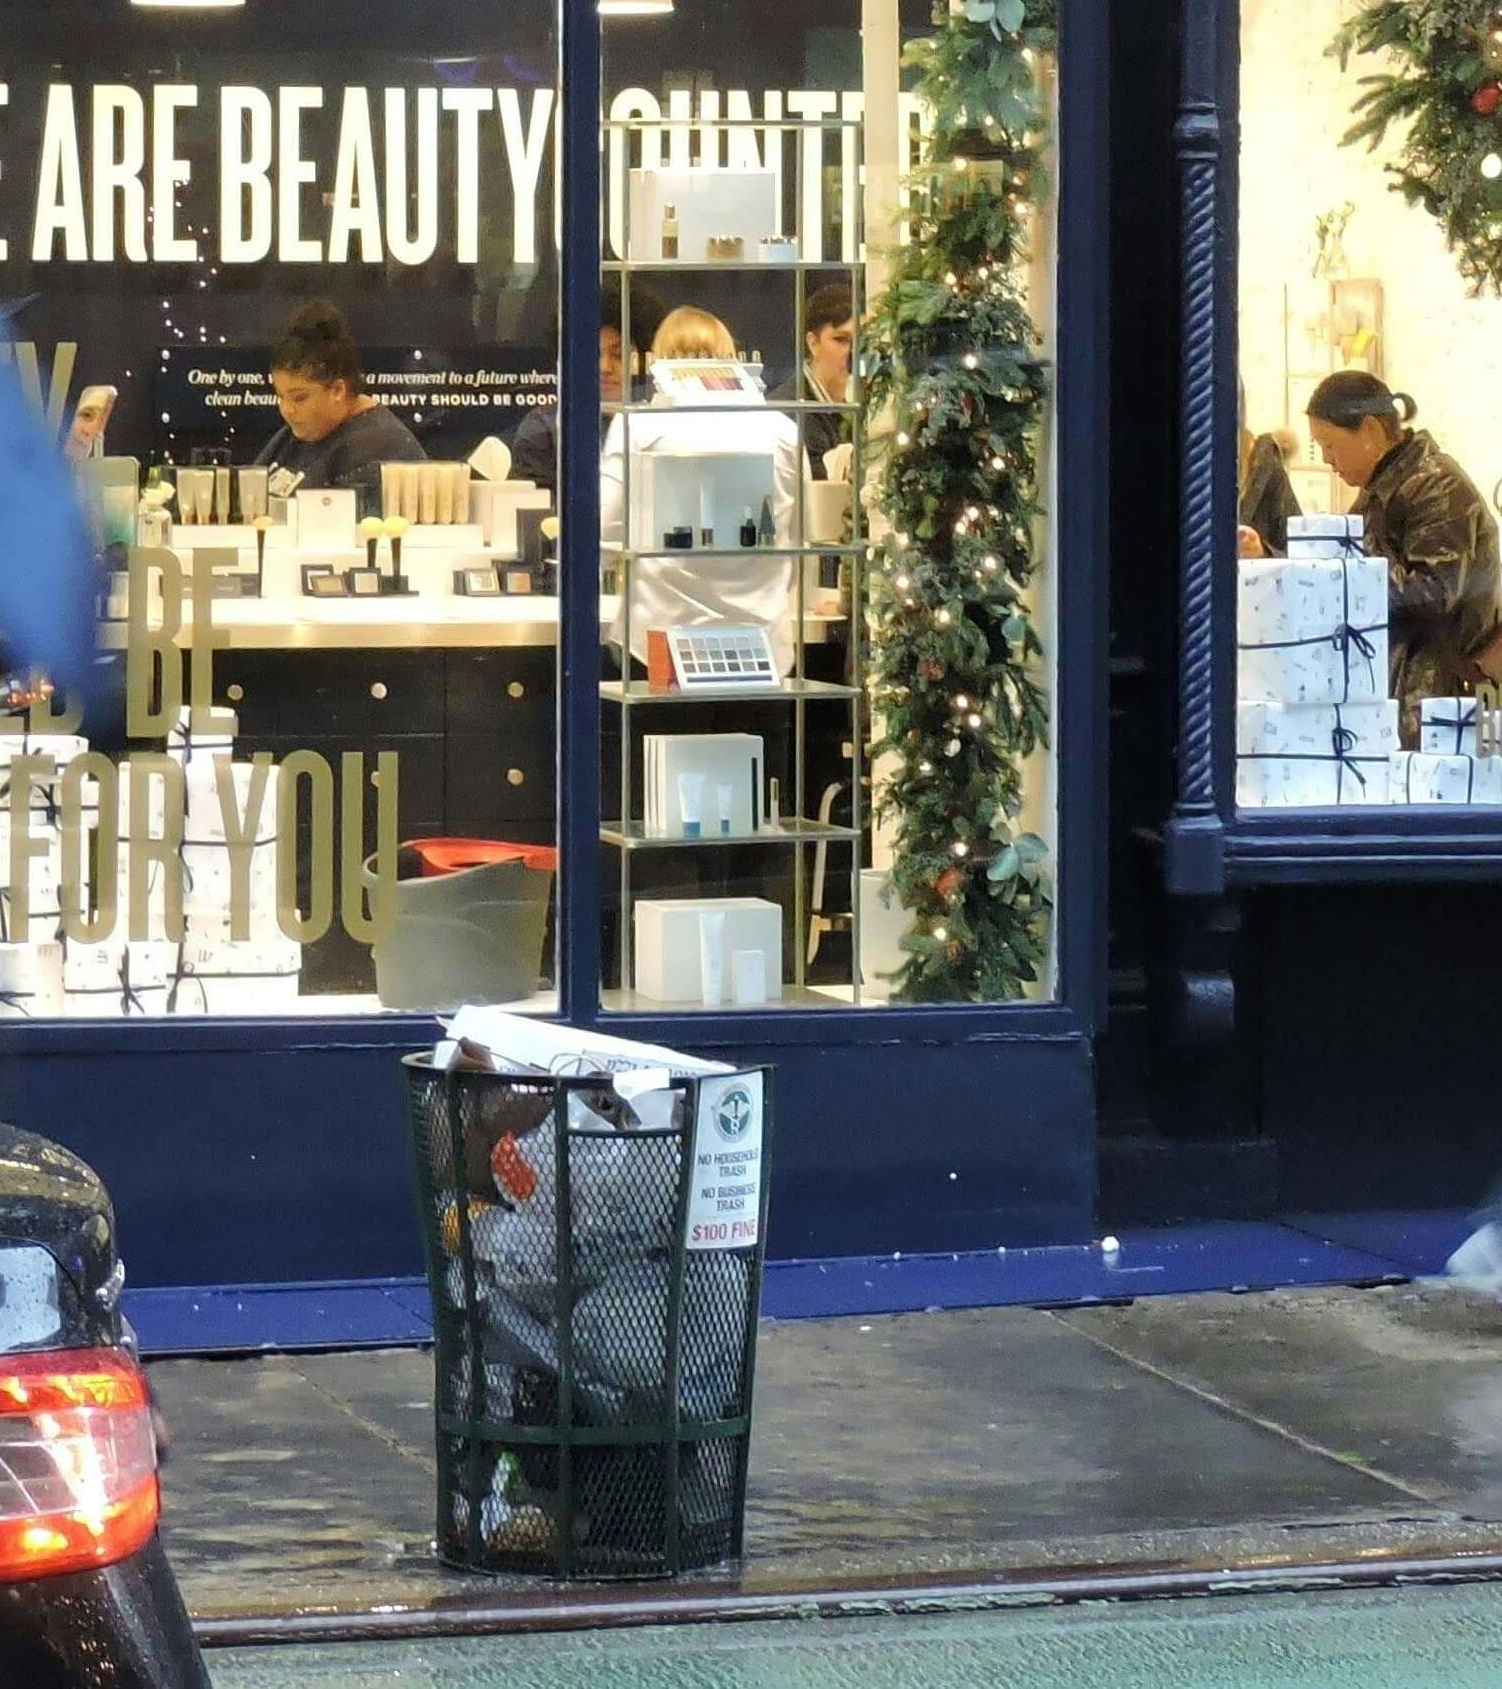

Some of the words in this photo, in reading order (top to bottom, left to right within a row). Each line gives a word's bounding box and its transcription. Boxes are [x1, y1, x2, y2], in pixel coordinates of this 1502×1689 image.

[31, 83, 199, 264] ARE
[219, 85, 937, 266] BEAUTYONTER
[187, 369, 217, 385] One
[219, 369, 236, 388] by
[237, 373, 265, 386] one,
[366, 373, 376, 384] a
[377, 372, 446, 384] movement
[449, 371, 463, 384] to
[464, 373, 474, 384] a
[473, 370, 518, 388] future
[519, 369, 558, 384] where
[205, 391, 242, 406] clean
[244, 391, 282, 406] beau
[372, 394, 427, 406] BEAUTY
[431, 394, 489, 406] SHOULD
[493, 394, 512, 406] BE
[126, 546, 240, 738] BE
[9, 749, 185, 945] FOR
[212, 749, 399, 945] YOU
[698, 1153, 712, 1166] NO
[719, 1165, 746, 1178] TRASH
[701, 1187, 715, 1199] NO
[716, 1199, 745, 1212] TRASH
[692, 1223, 728, 1242] $100
[731, 1219, 756, 1239] FINE
